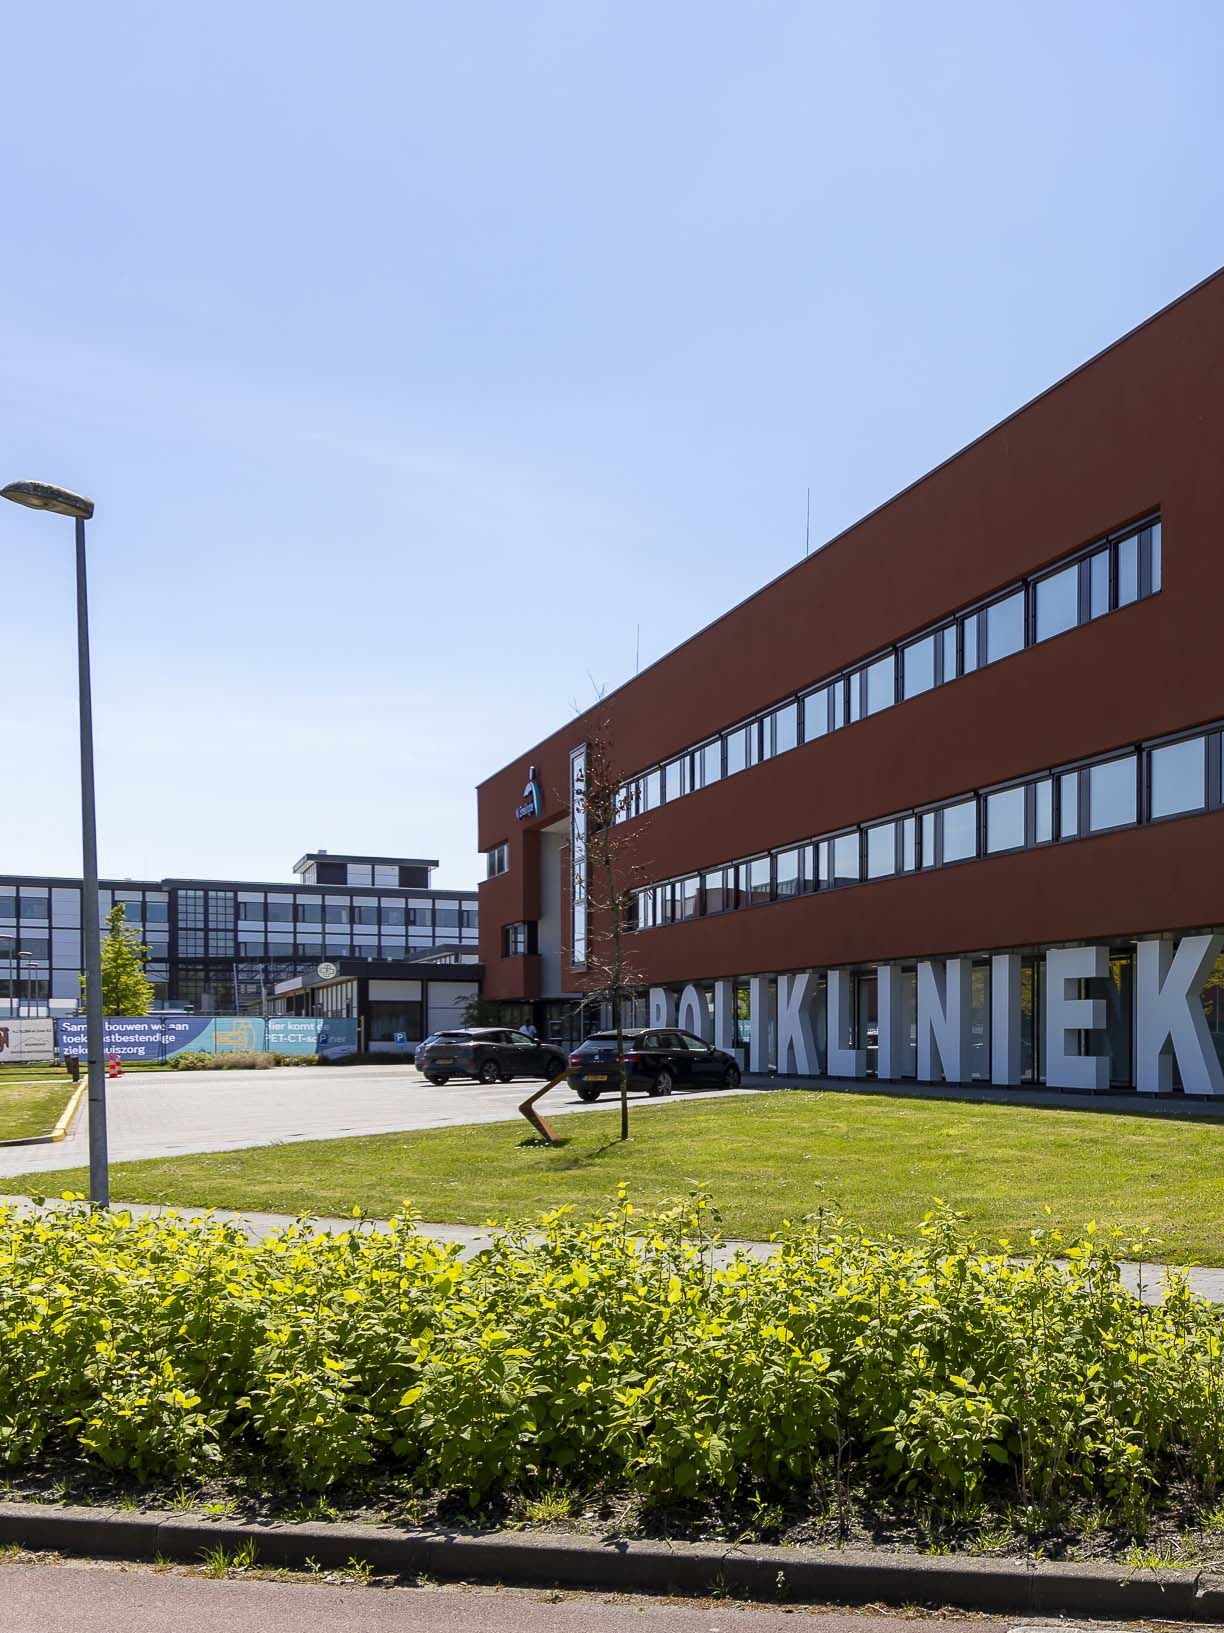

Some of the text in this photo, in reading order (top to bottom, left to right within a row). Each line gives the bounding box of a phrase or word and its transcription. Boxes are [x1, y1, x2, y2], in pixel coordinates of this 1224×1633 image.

[62, 1022, 88, 1032] Sam
[104, 1021, 149, 1032] bouwen
[287, 1021, 315, 1031] komt
[62, 1033, 176, 1044] toekstbestendige
[319, 1034, 327, 1043] P
[397, 1033, 404, 1042] P
